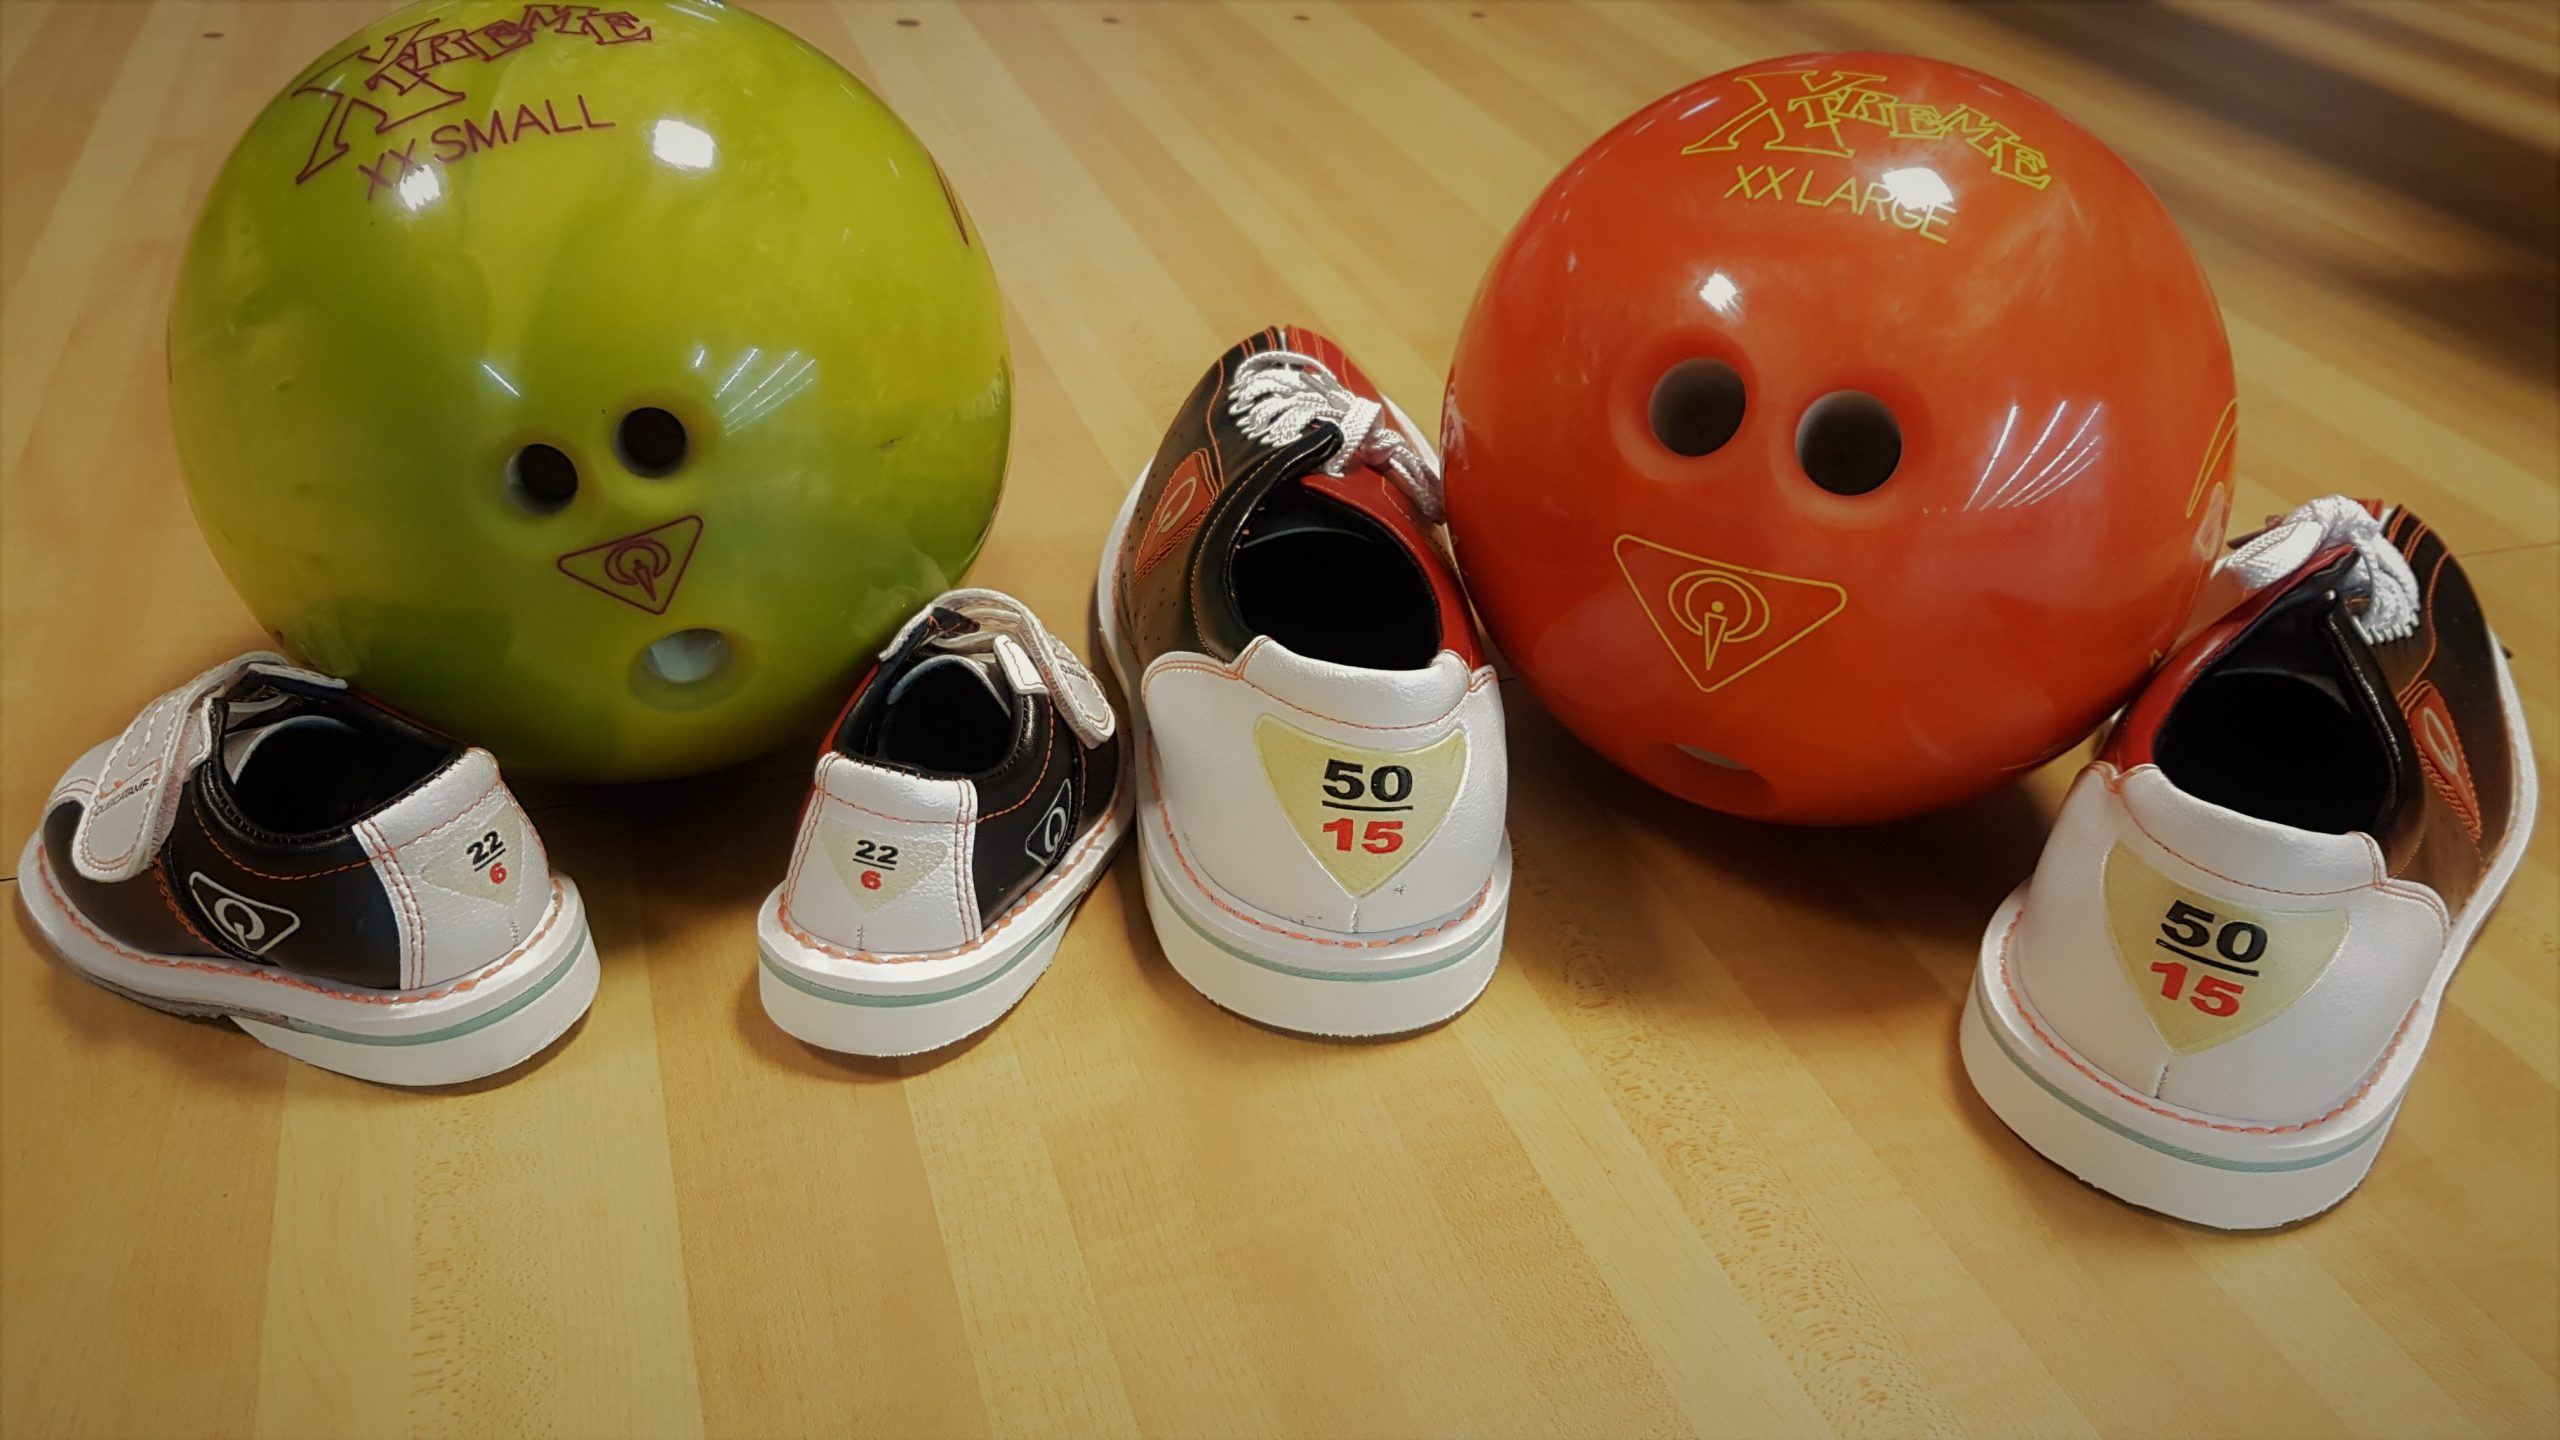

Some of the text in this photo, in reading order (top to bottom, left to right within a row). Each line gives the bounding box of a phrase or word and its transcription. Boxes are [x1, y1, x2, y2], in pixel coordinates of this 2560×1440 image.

[358, 94, 617, 201] XX SMALL
[1723, 164, 1958, 245] XX LARGE
[1322, 758, 1413, 803] 50
[466, 830, 504, 866] 22
[855, 839, 899, 865] 22
[1322, 817, 1404, 855] 15
[489, 862, 508, 885] 6
[860, 870, 882, 890] 6
[2161, 899, 2268, 963] 50
[2150, 961, 2245, 1017] 15
